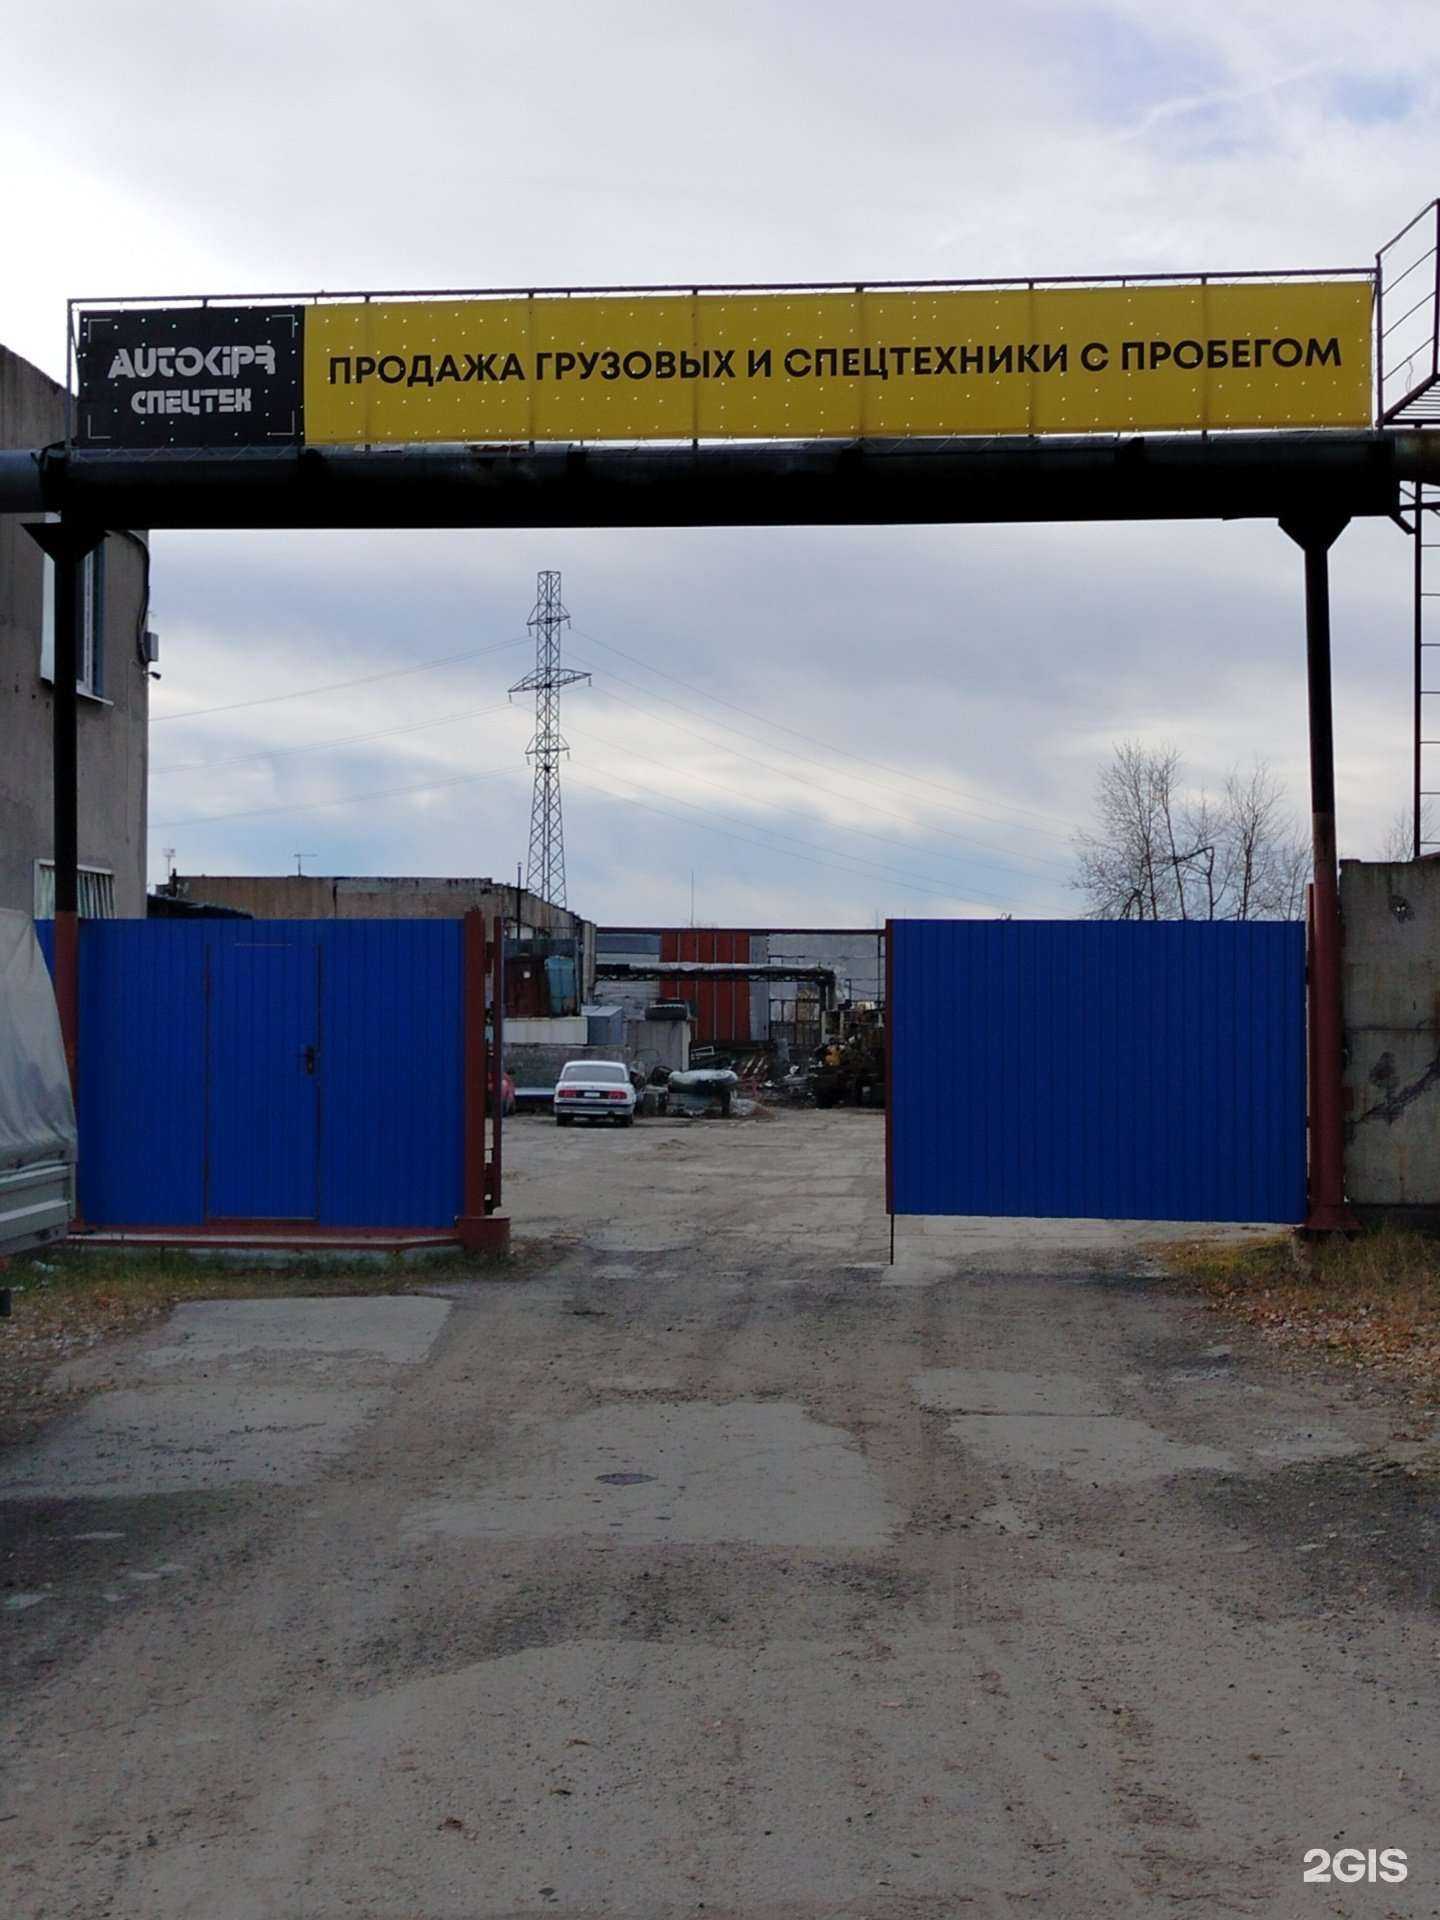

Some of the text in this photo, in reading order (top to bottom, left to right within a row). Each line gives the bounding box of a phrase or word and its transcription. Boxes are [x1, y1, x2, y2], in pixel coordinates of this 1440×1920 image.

[329, 337, 1342, 387] ПРОДАЖА ГРУЗОВЫХ И СПЕЦТЕХНИКИ С ПРОБЕГОМ
